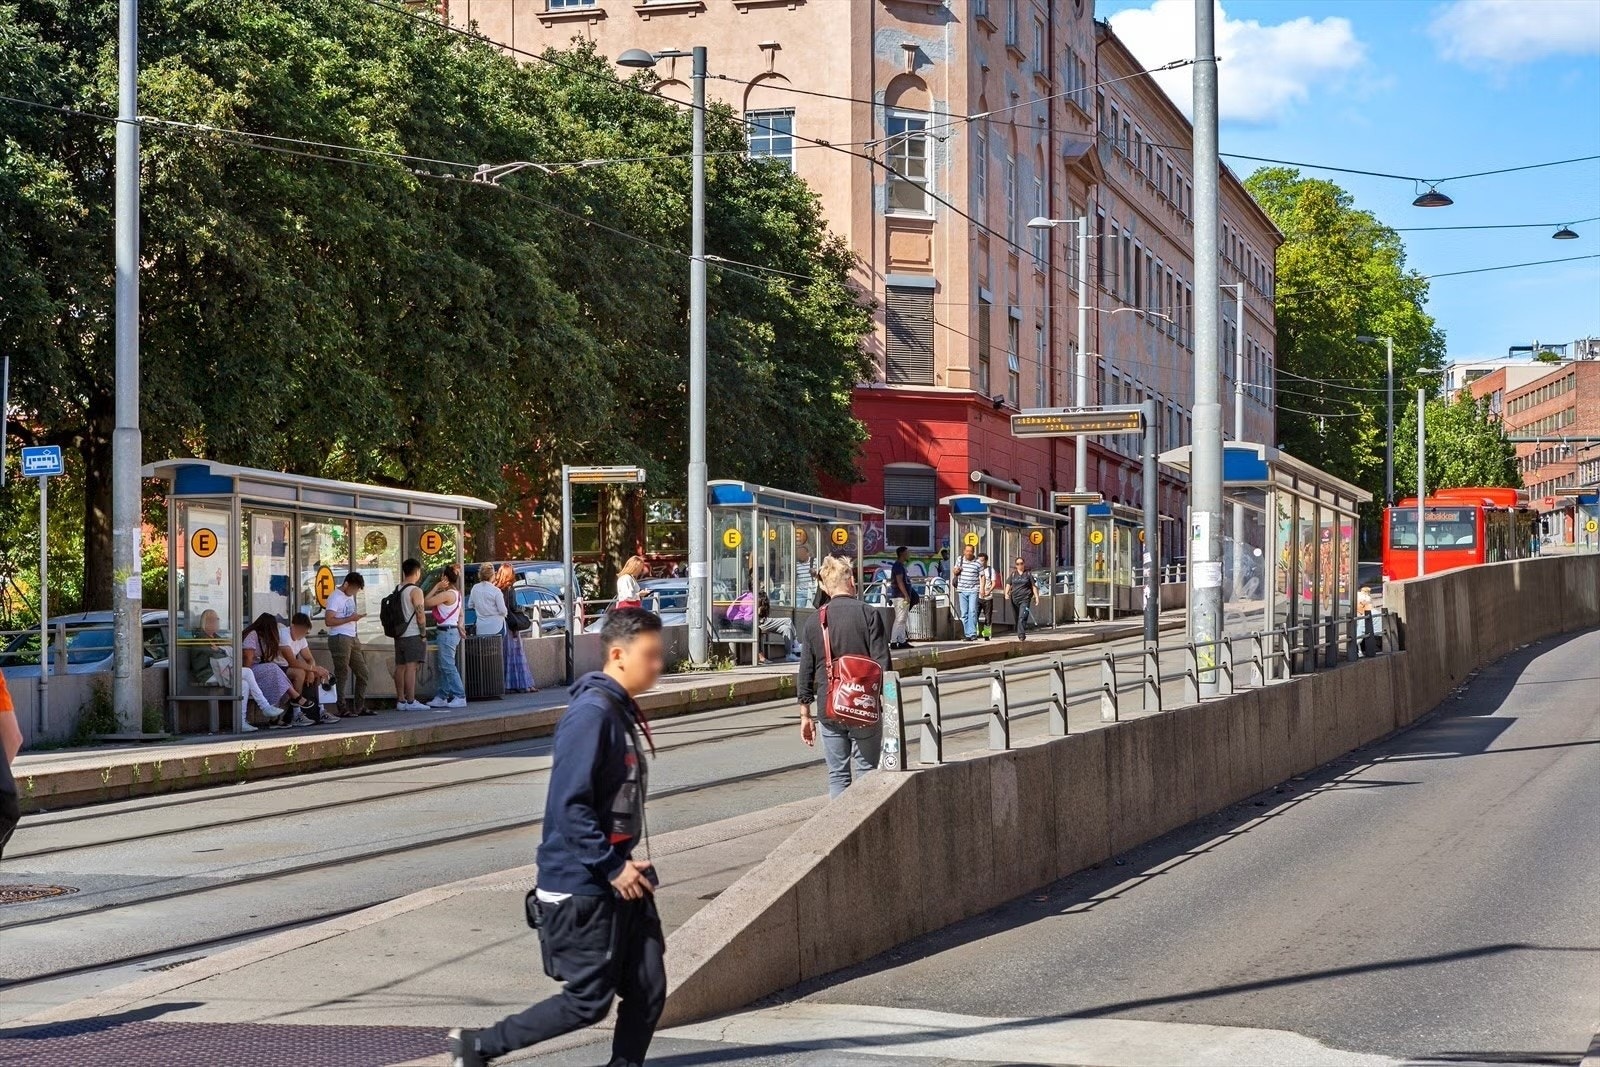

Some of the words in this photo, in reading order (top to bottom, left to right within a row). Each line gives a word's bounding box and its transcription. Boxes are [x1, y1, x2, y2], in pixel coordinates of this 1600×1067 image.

[1590, 522, 1595, 530] D
[728, 532, 737, 544] E
[836, 531, 844, 541] E
[968, 535, 975, 544] F
[1033, 533, 1040, 543] F
[1093, 532, 1100, 541] F
[199, 534, 210, 551] E
[426, 535, 436, 550] E
